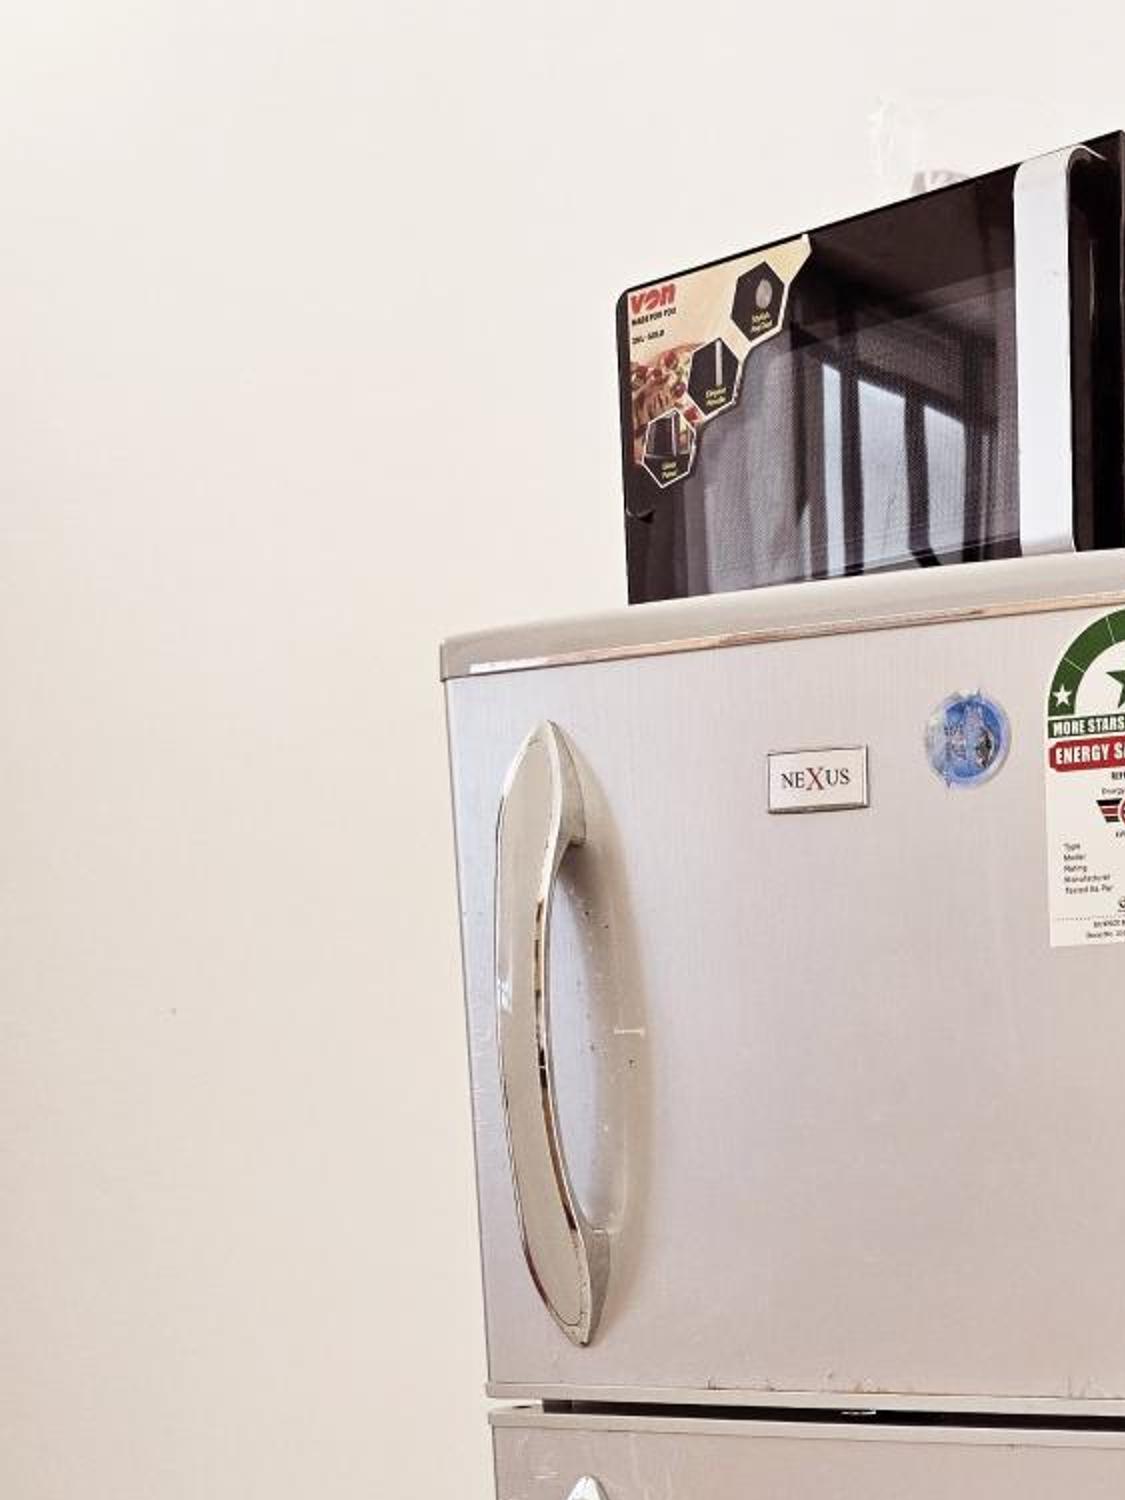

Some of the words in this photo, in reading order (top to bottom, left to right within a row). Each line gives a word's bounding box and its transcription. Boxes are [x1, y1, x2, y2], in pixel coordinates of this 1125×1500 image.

[1053, 721, 1085, 737] MORE
[1055, 743, 1110, 765] ENERGY
[781, 766, 851, 791] NEXUS
